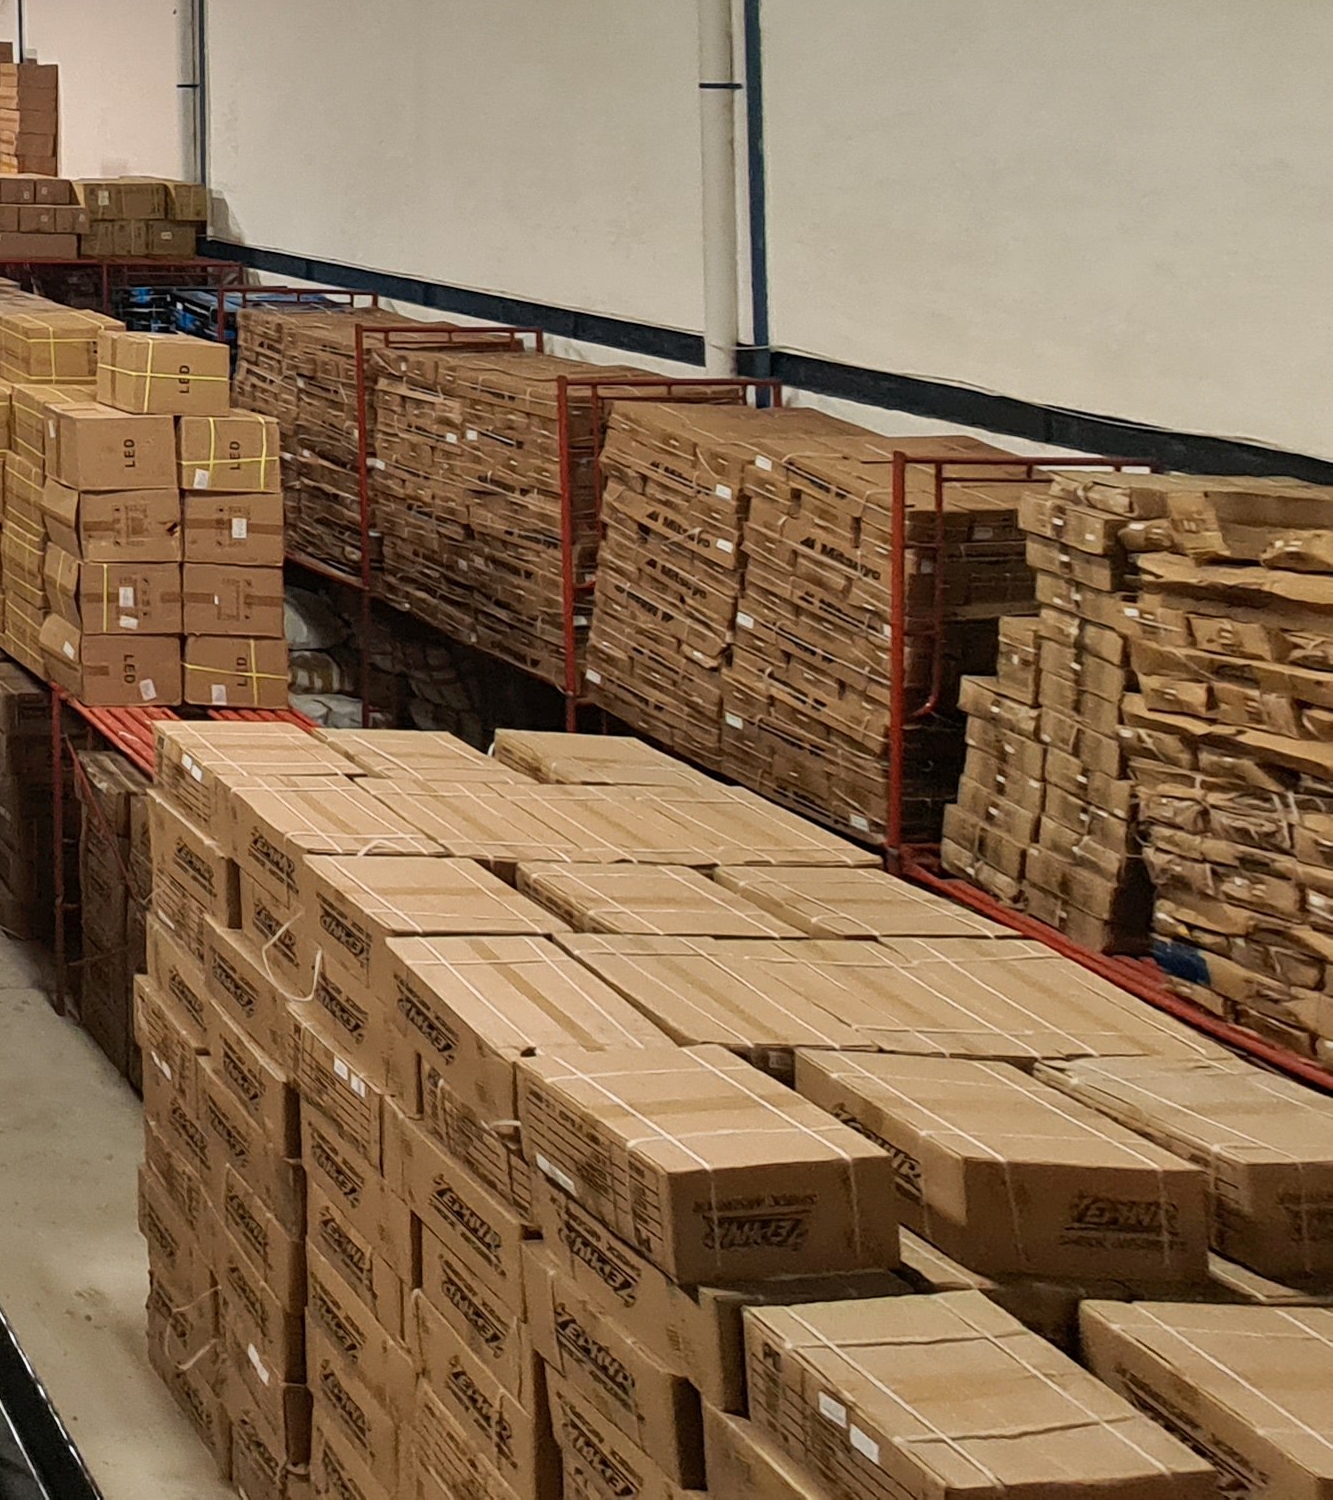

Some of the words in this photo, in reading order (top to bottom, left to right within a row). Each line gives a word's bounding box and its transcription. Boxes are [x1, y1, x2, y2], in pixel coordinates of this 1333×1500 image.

[123, 437, 136, 468] LED
[229, 440, 242, 471] LED
[123, 654, 137, 685] LED
